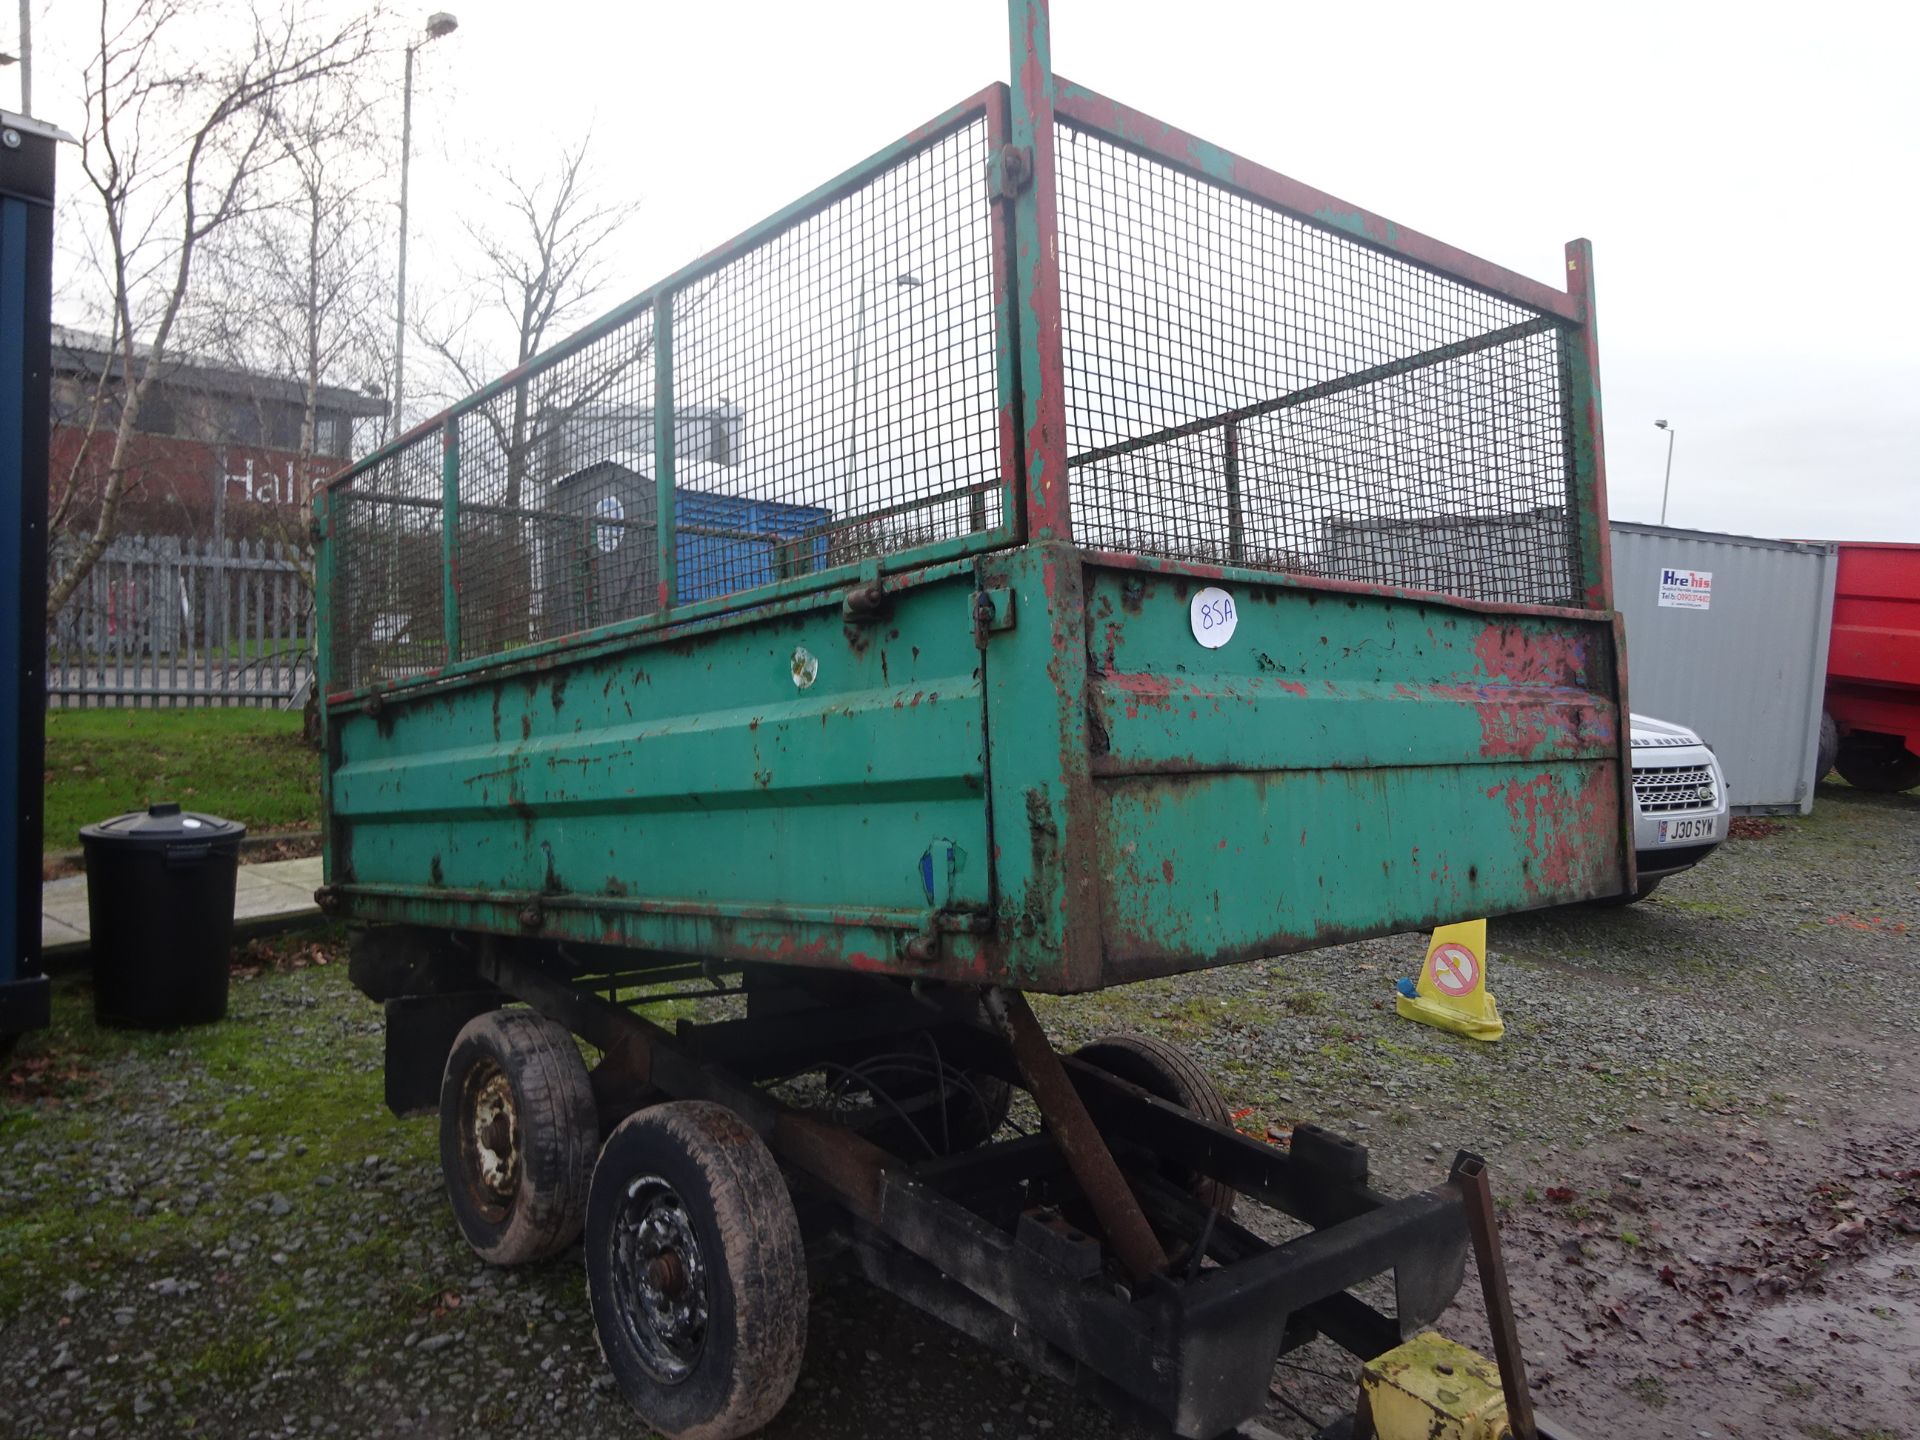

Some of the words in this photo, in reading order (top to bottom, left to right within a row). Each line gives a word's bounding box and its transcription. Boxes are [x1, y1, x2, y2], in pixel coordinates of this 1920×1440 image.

[1201, 598, 1233, 630] 85A
[1654, 737, 1694, 746] ROVER
[1671, 820, 1693, 839] J30
